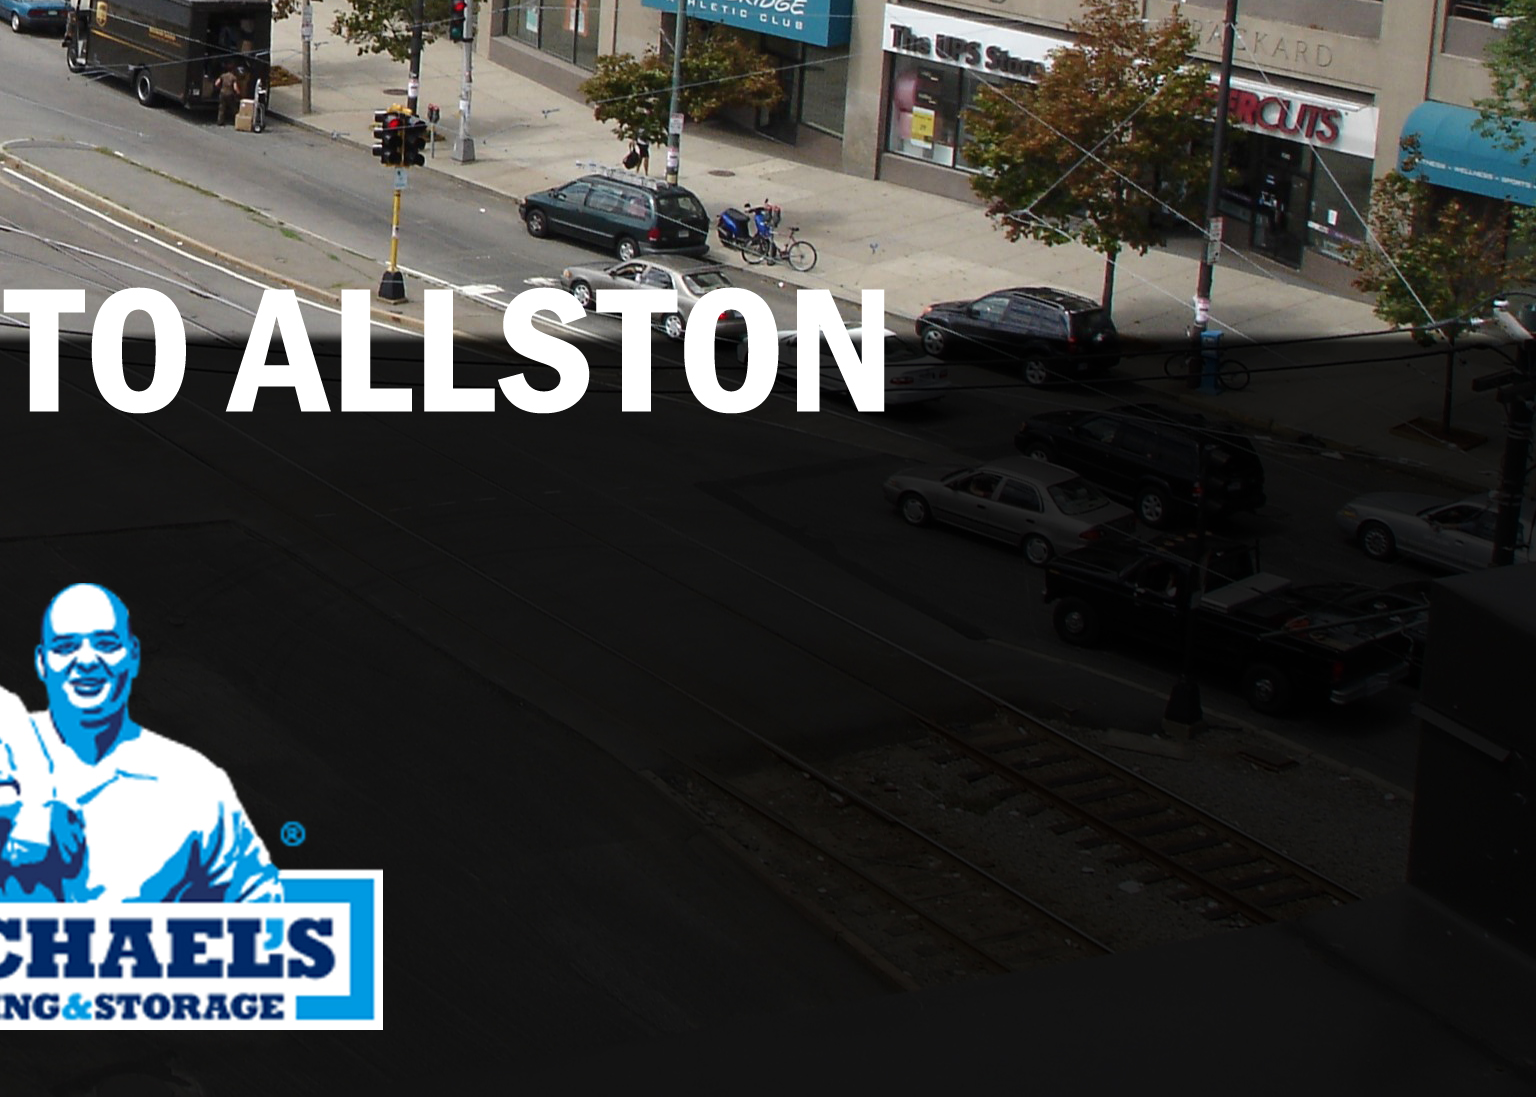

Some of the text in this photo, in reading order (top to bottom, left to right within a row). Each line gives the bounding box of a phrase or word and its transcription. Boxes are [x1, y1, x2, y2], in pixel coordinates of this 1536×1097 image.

[760, 13, 803, 31] CLUB
[890, 23, 932, 55] The
[936, 33, 982, 66] UPS
[1202, 83, 1342, 144] ERCUTS
